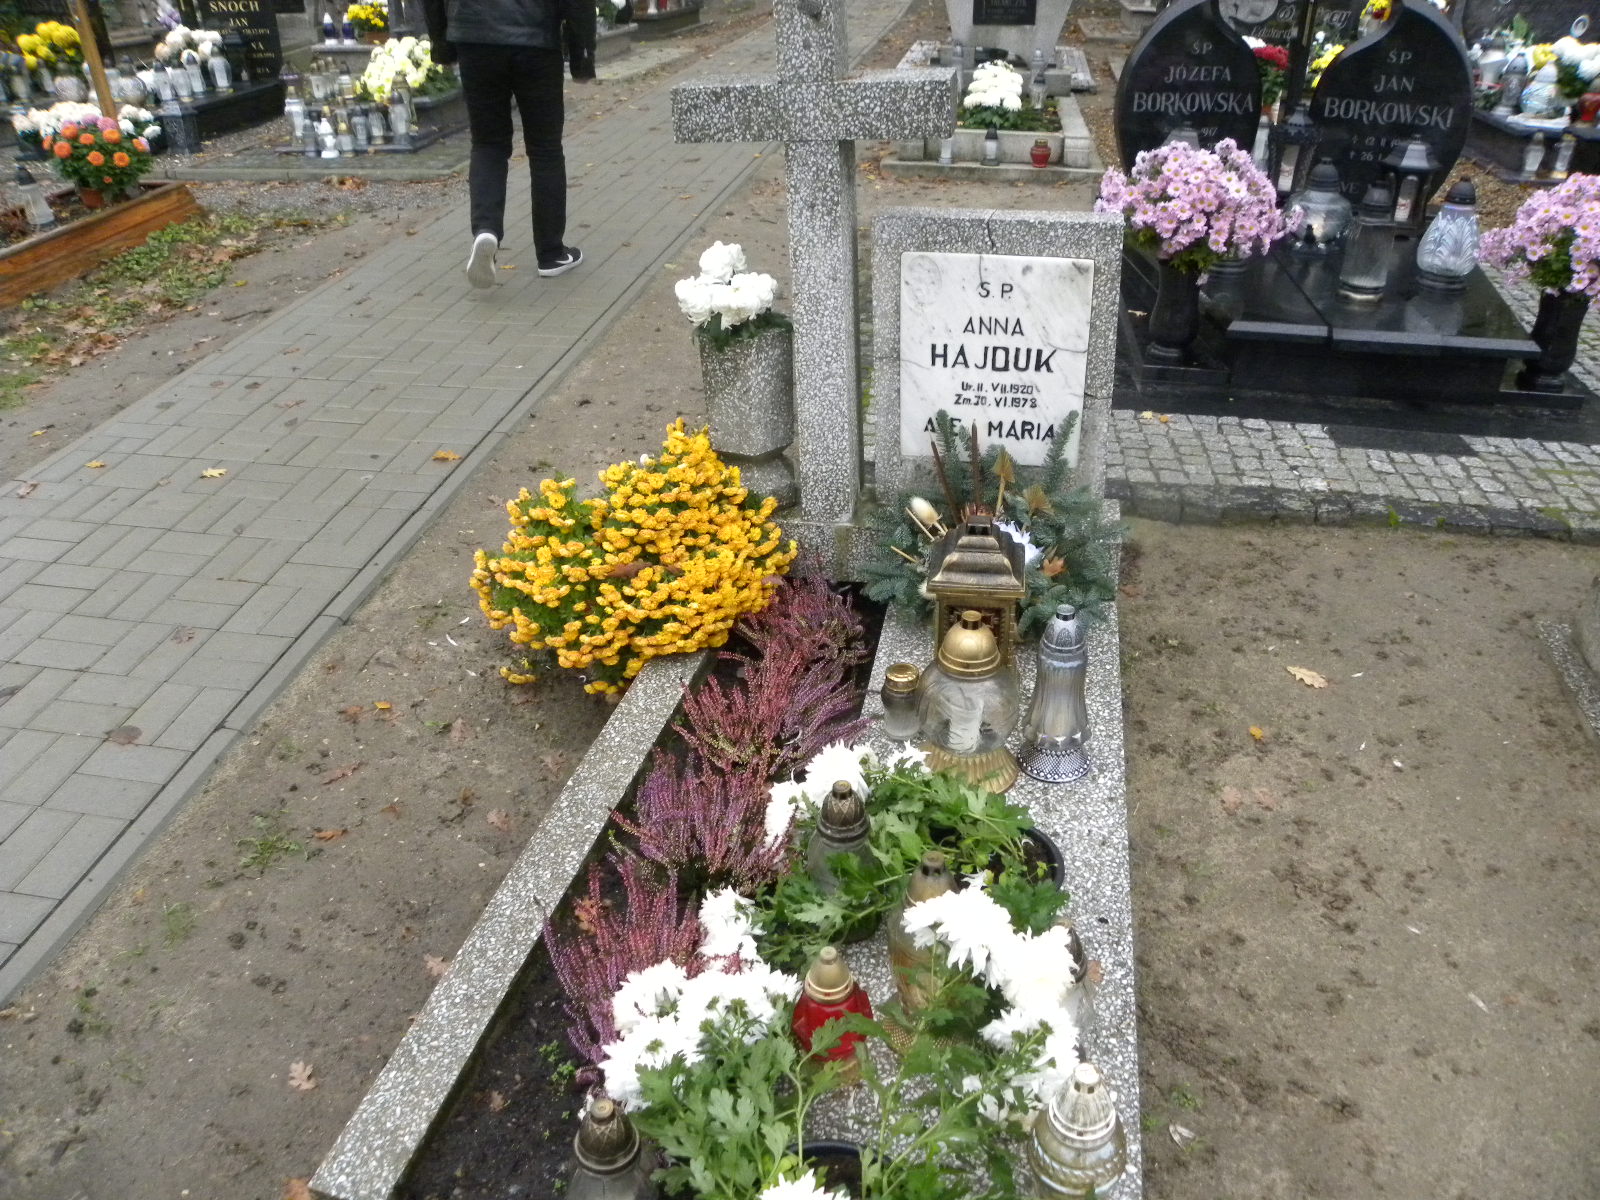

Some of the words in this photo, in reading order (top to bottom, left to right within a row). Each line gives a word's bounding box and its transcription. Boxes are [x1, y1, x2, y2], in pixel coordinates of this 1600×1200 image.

[209, 0, 260, 13] SNOCH
[1164, 64, 1232, 84] JÓZEFA
[1373, 74, 1415, 93] JAN
[1133, 91, 1253, 116] BORKOWSKA
[1324, 96, 1455, 130] BORKOWSKI
[963, 316, 1025, 337] ANNA
[988, 419, 1056, 442] MARIA
